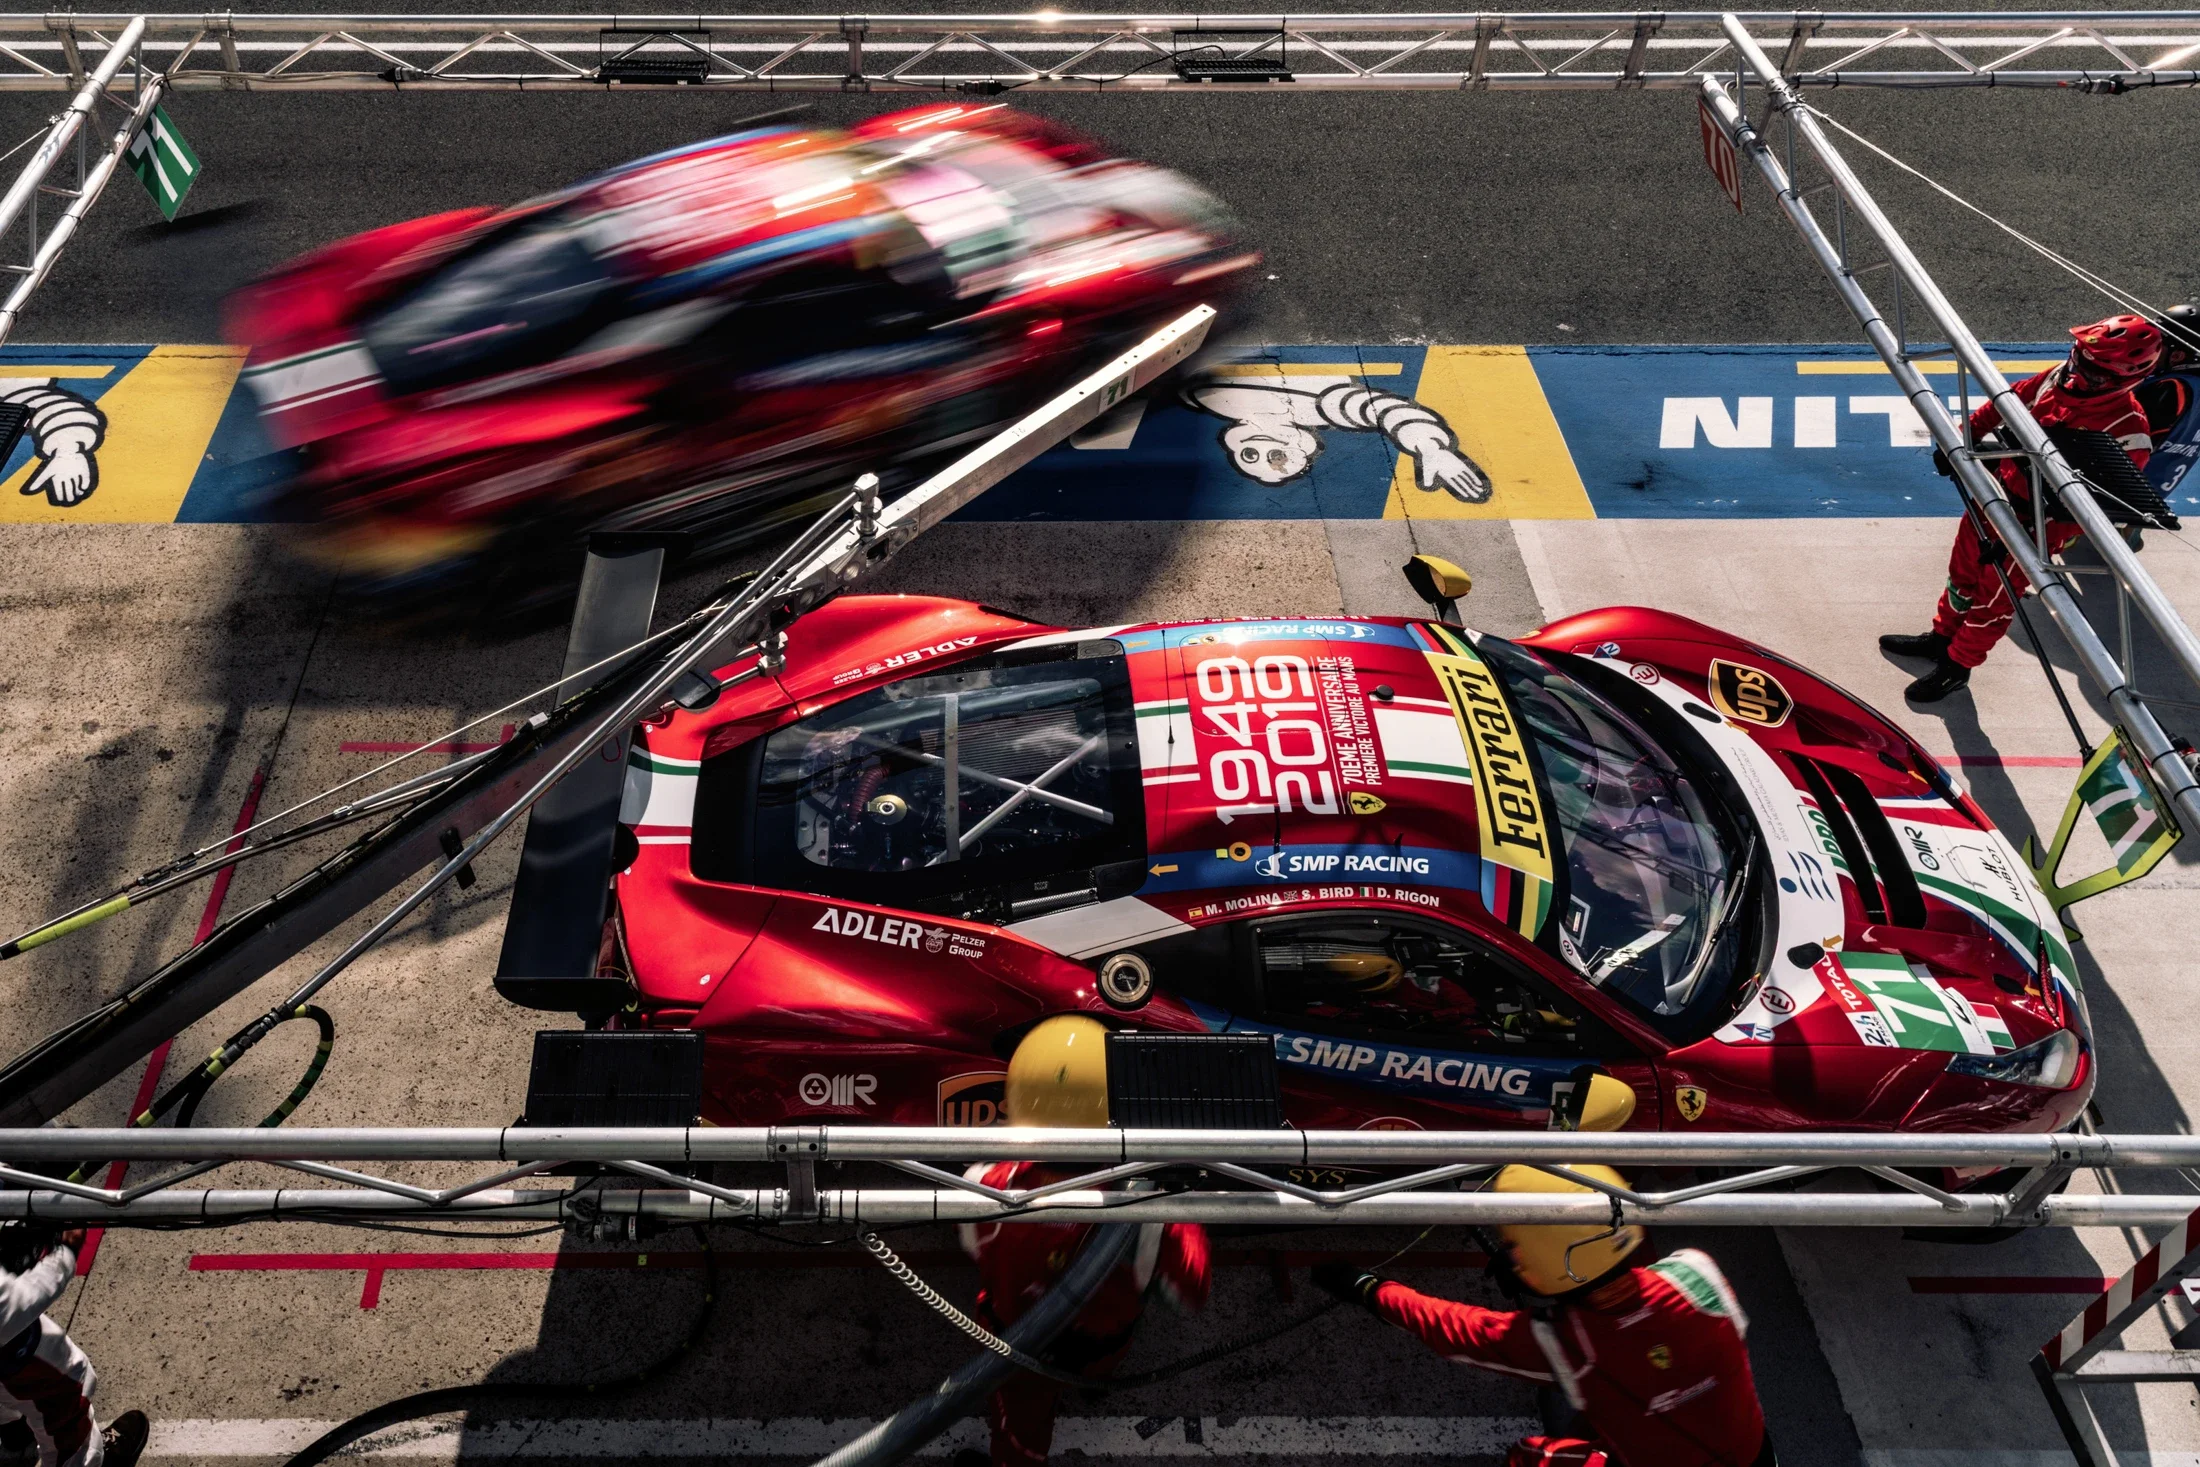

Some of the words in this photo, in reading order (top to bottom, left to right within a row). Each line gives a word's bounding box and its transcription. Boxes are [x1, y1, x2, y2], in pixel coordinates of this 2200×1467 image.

[130, 112, 194, 203] 71
[1702, 108, 1738, 203] 70
[1107, 375, 1129, 406] 71
[2160, 464, 2187, 491] 3
[1304, 624, 1346, 636] SMP
[884, 636, 978, 668] ADLER
[1337, 656, 1358, 680] MANS
[1317, 656, 1355, 739] ANNIVERSAIRE
[1344, 683, 1361, 694] AU
[1254, 655, 1339, 815] 2019
[1347, 696, 1370, 735] VICTOIRE
[1196, 656, 1275, 825] 1949
[1356, 737, 1382, 785] PREMIERE
[1336, 742, 1365, 785] 70EME
[1441, 665, 1546, 860] Ferrari
[2089, 759, 2158, 861] 71
[1288, 855, 1340, 872] SMP
[1344, 855, 1430, 874] RACING
[1986, 846, 2023, 902] HUBLOT
[1205, 903, 1222, 916] M.
[1225, 892, 1281, 911] MOLINA
[1301, 889, 1315, 900] S.
[1319, 886, 1354, 899] BIRD
[1376, 887, 1391, 899] D.
[1394, 889, 1440, 908] RIGON
[812, 907, 924, 950] ADLER
[951, 933, 986, 948] PELZER
[949, 944, 983, 959] GROUP
[1821, 954, 1864, 1011] TOTAL
[1845, 967, 1954, 1033] 71
[1286, 1036, 1377, 1073] SMP
[1380, 1050, 1532, 1096] RACING
